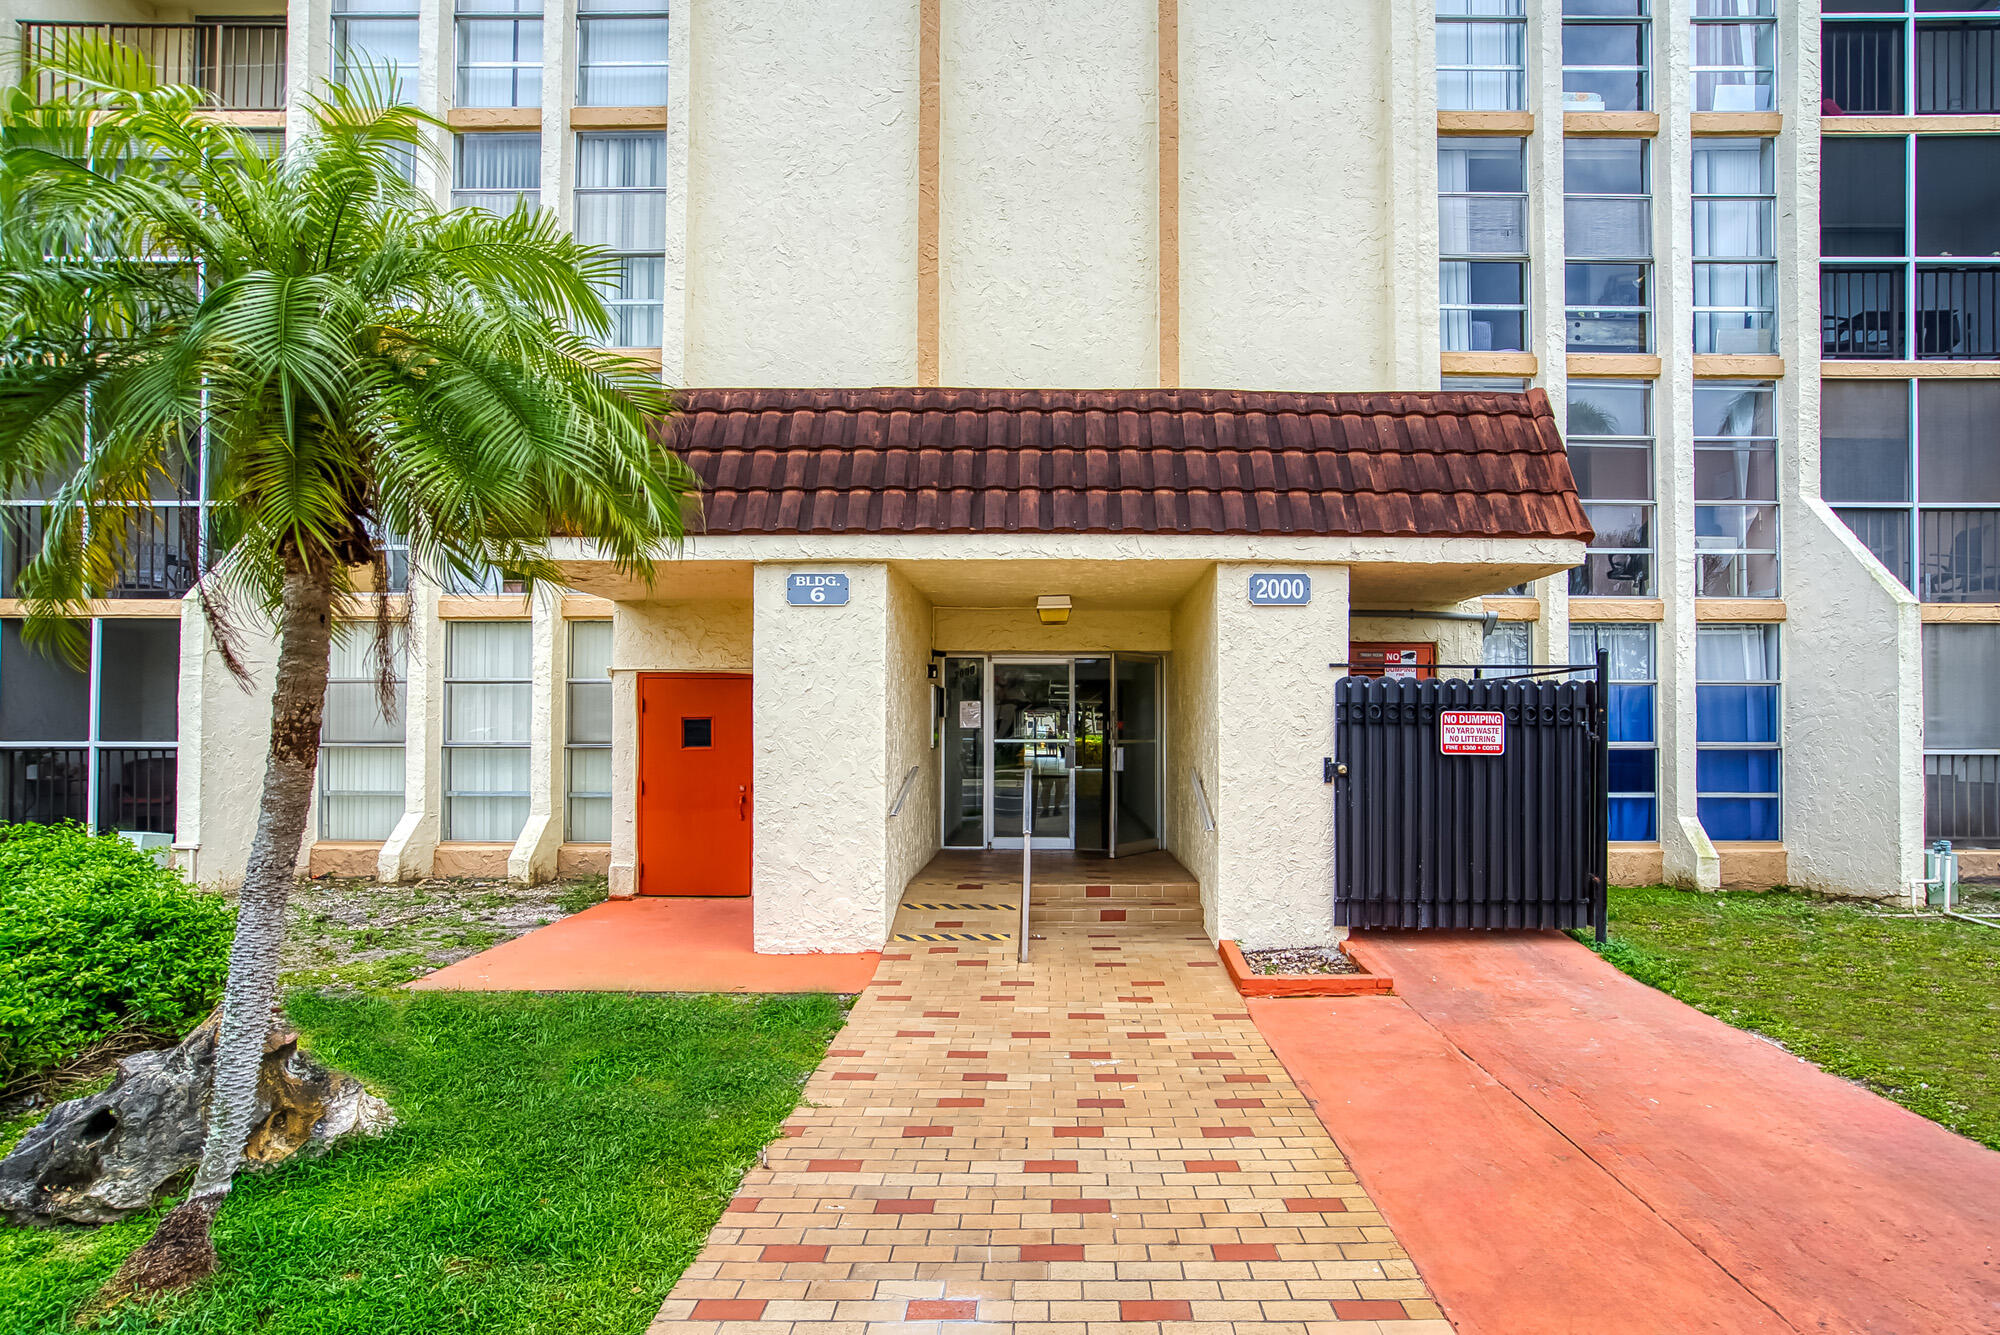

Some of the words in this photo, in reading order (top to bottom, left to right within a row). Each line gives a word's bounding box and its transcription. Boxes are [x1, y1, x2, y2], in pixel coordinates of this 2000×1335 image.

[795, 575, 841, 587] BLDG.
[1256, 578, 1304, 599] 2000
[810, 586, 826, 603] 6
[1386, 653, 1400, 661] NO
[1444, 714, 1457, 724] NO
[1458, 714, 1501, 724] DUMPING
[1476, 727, 1500, 735] WASTE
[1461, 735, 1496, 743] LITTERING
